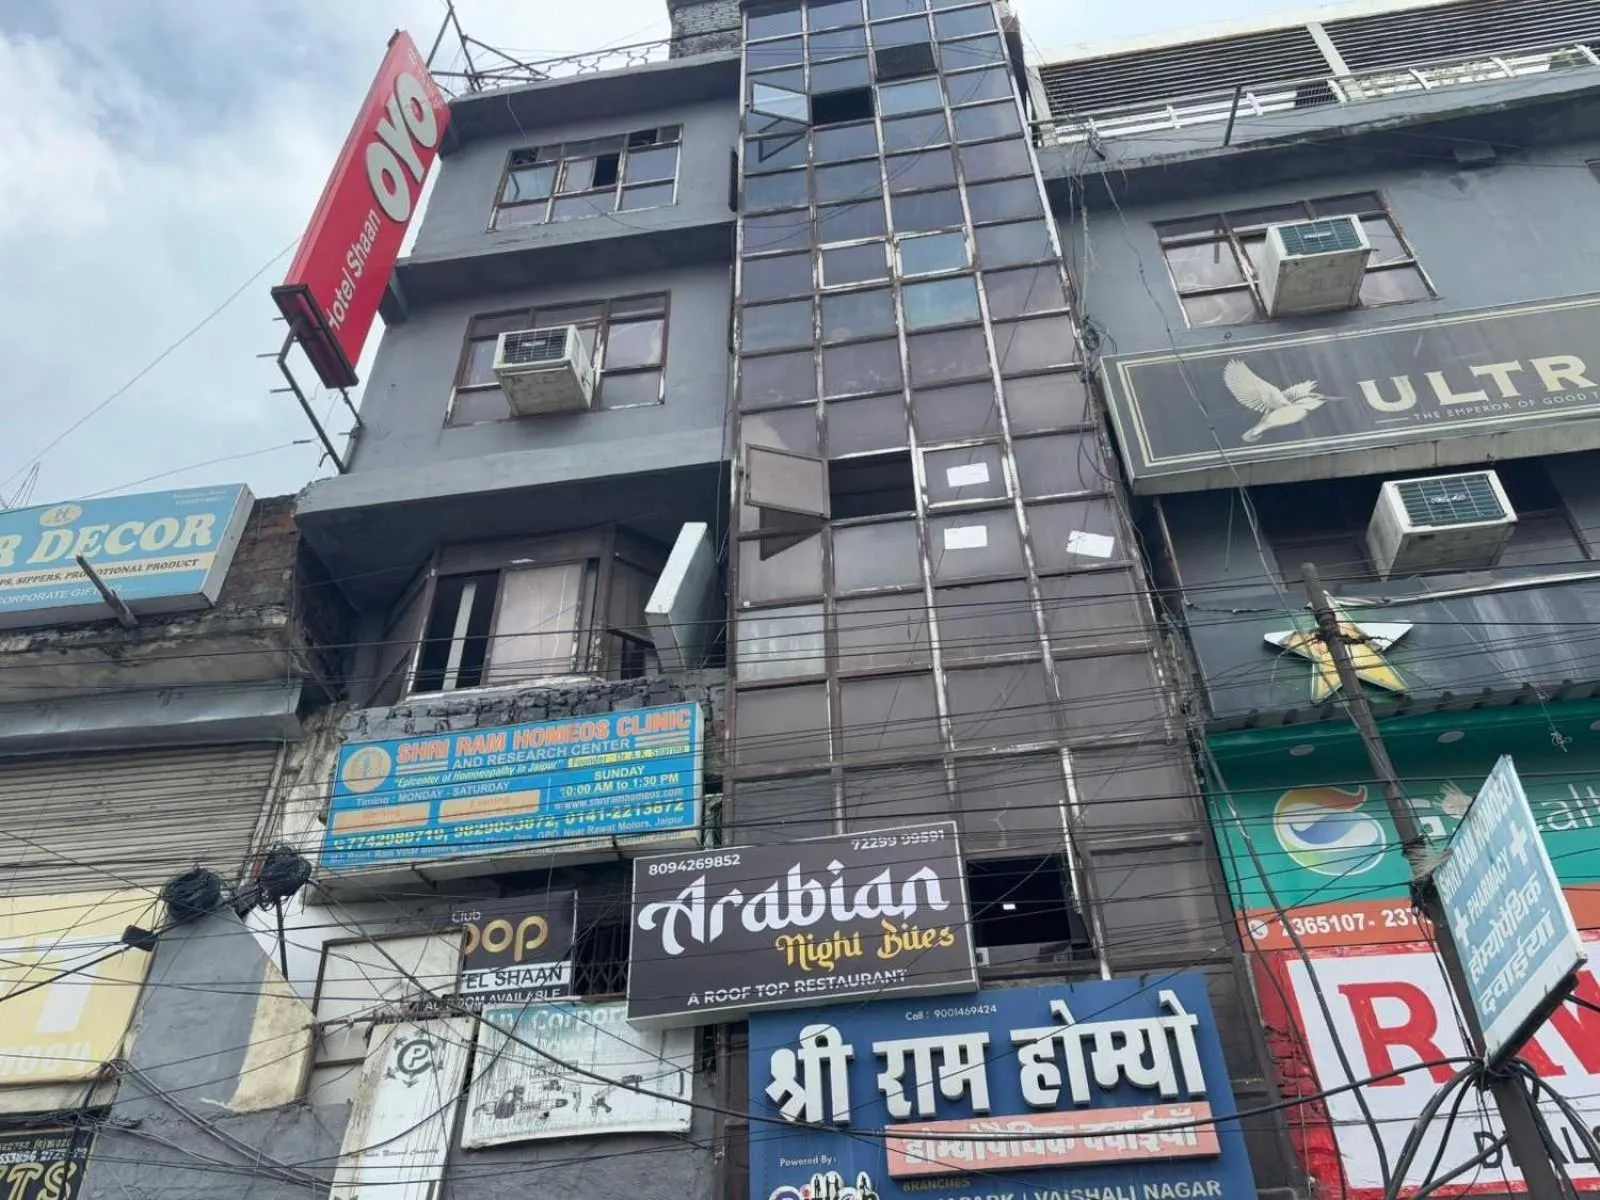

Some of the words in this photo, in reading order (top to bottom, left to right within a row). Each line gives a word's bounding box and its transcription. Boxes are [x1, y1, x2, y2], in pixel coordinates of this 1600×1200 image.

[366, 72, 438, 223] OYO
[347, 208, 381, 278] Shaan
[1358, 355, 1599, 412] ULTR
[1412, 410, 1441, 421] THE
[1449, 402, 1512, 418] EMPEROR
[1518, 398, 1537, 408] OF
[1542, 392, 1587, 405] GOOD
[26, 513, 216, 564] DECOR
[147, 558, 200, 570] PRODUCT
[397, 738, 450, 764] SHRI
[455, 731, 507, 757] RAM
[513, 719, 612, 750] HOMEOS
[616, 708, 692, 738] CLINIC
[452, 757, 486, 769] AND
[487, 746, 569, 765] RESEARCH
[571, 739, 631, 755] CENTER
[594, 765, 645, 781] SUNDAY
[594, 780, 613, 793] AM
[617, 780, 629, 790] to
[634, 775, 657, 787] 1:30
[660, 772, 680, 785] PM
[399, 789, 443, 801] MONDAY
[453, 781, 510, 794] SATURDAY
[649, 853, 741, 876] 8094269852
[1437, 859, 1461, 905] SHRI
[1457, 833, 1479, 879] RAM
[1466, 845, 1513, 925] PHARMACY
[638, 859, 950, 955] Arabian
[775, 930, 863, 972] Night
[876, 918, 955, 960] Bites
[494, 965, 563, 987] SHAAN
[687, 993, 700, 1006] A
[704, 986, 752, 1004] ROOF
[756, 982, 789, 998] TOP
[794, 969, 907, 994] RESTAURANT
[905, 1010, 924, 1022] Call
[934, 1003, 997, 1019] 9001469424
[765, 1023, 856, 1126] श्री
[873, 1031, 990, 1120] राम
[1009, 988, 1207, 1108] होम्यो
[779, 1156, 819, 1167] Powered
[902, 1177, 971, 1192] BRANCHES
[1143, 1180, 1222, 1200] NAGAR
